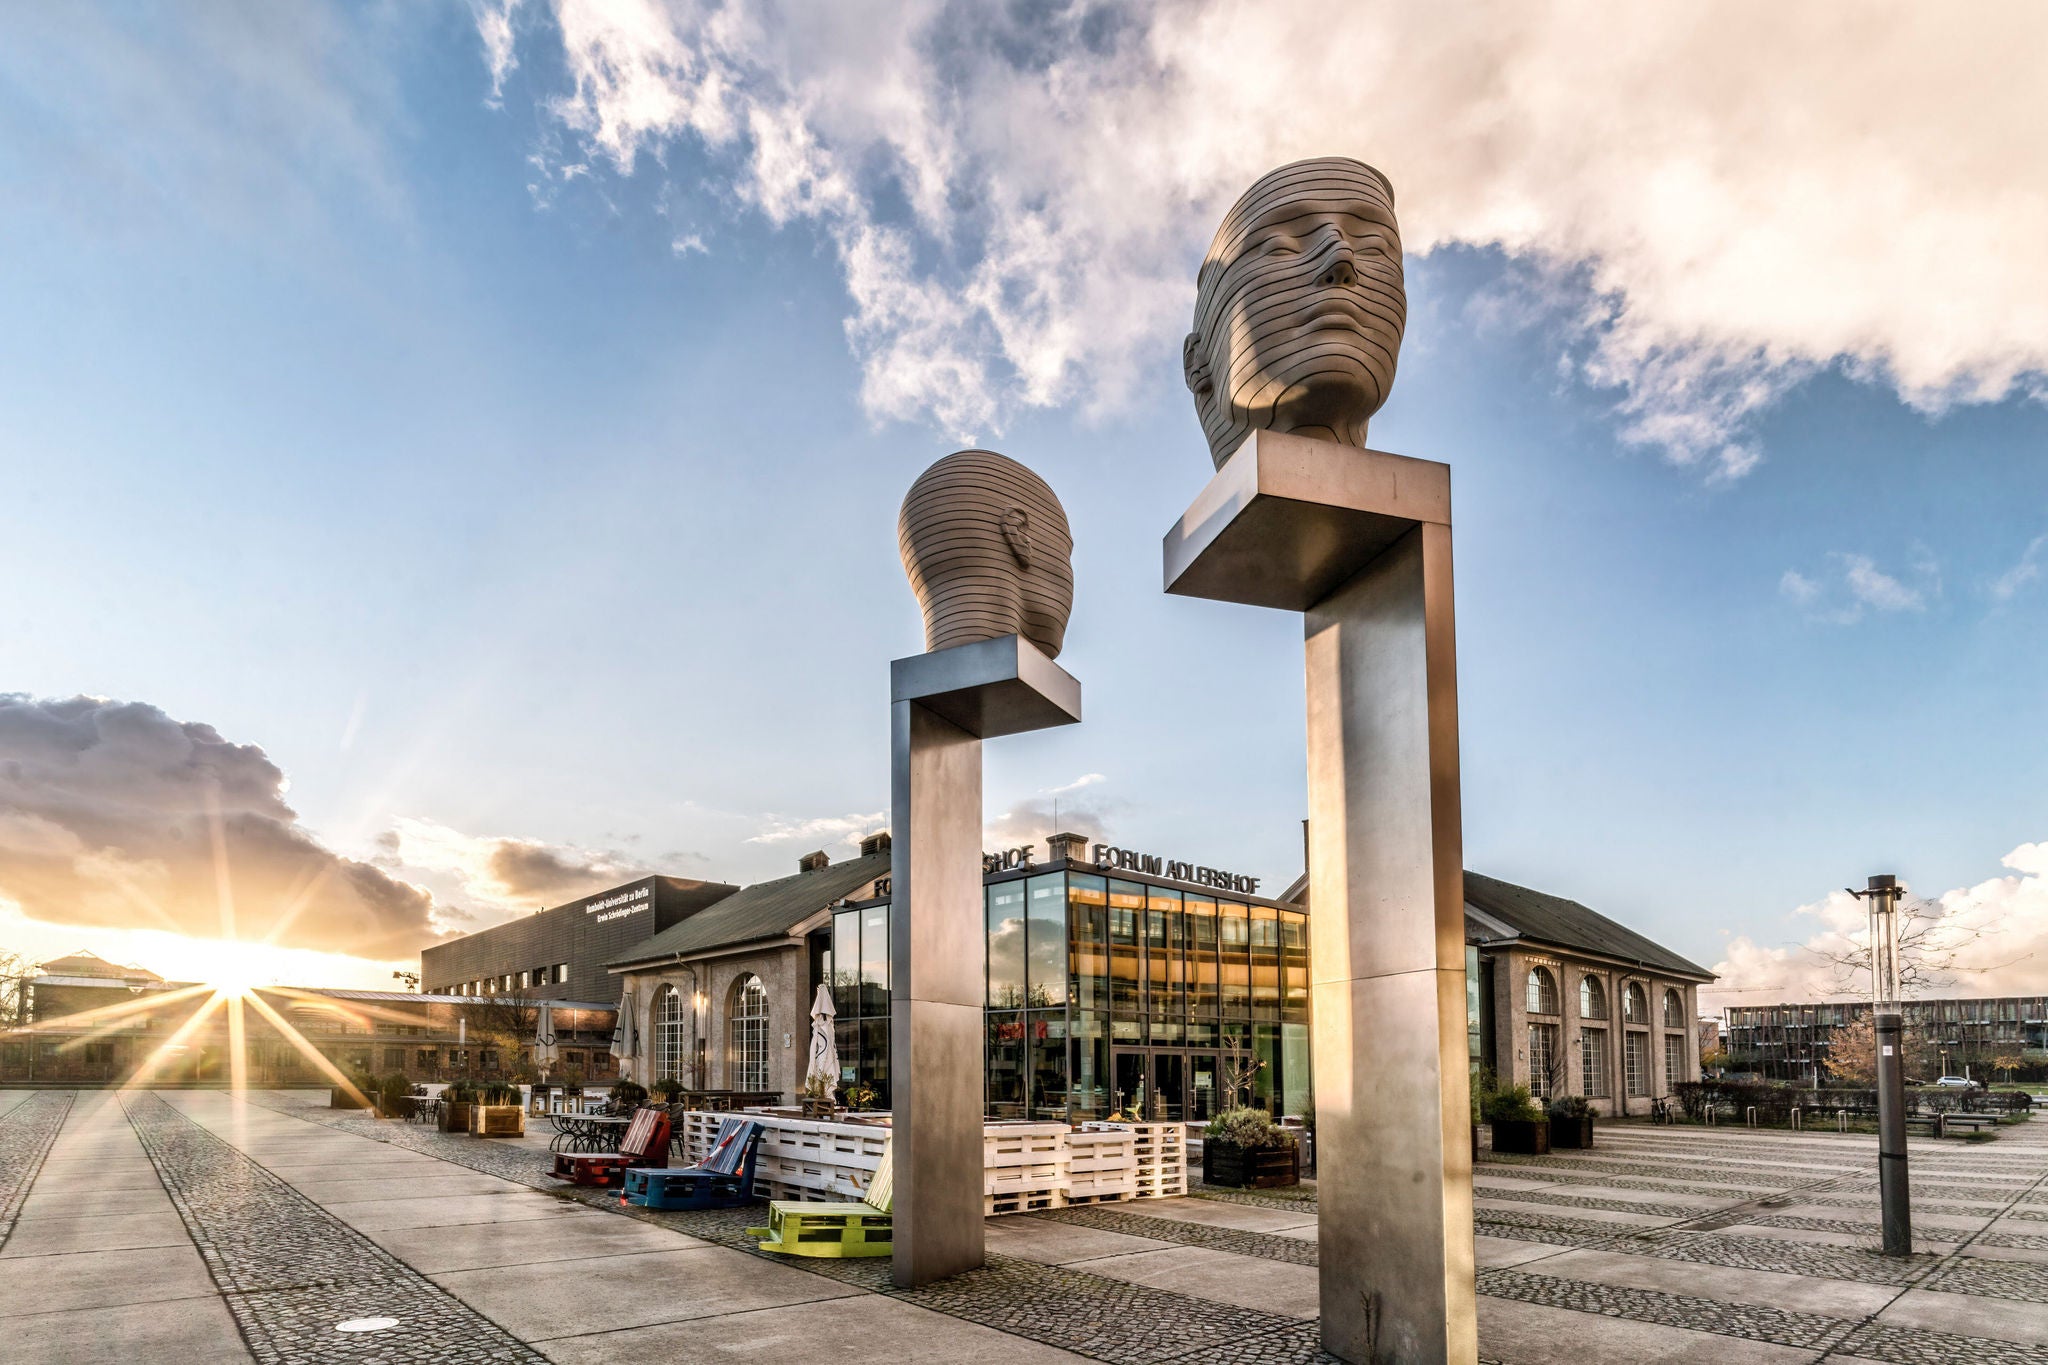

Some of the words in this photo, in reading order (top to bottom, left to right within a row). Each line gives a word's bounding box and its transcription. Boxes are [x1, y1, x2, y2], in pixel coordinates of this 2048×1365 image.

[874, 878, 891, 897] FO
[982, 845, 1034, 873] SHOF
[1092, 843, 1163, 876] FORUM
[1164, 860, 1261, 894] ADLERSHOF
[635, 888, 648, 899] Berlin
[597, 913, 608, 923] Erwin
